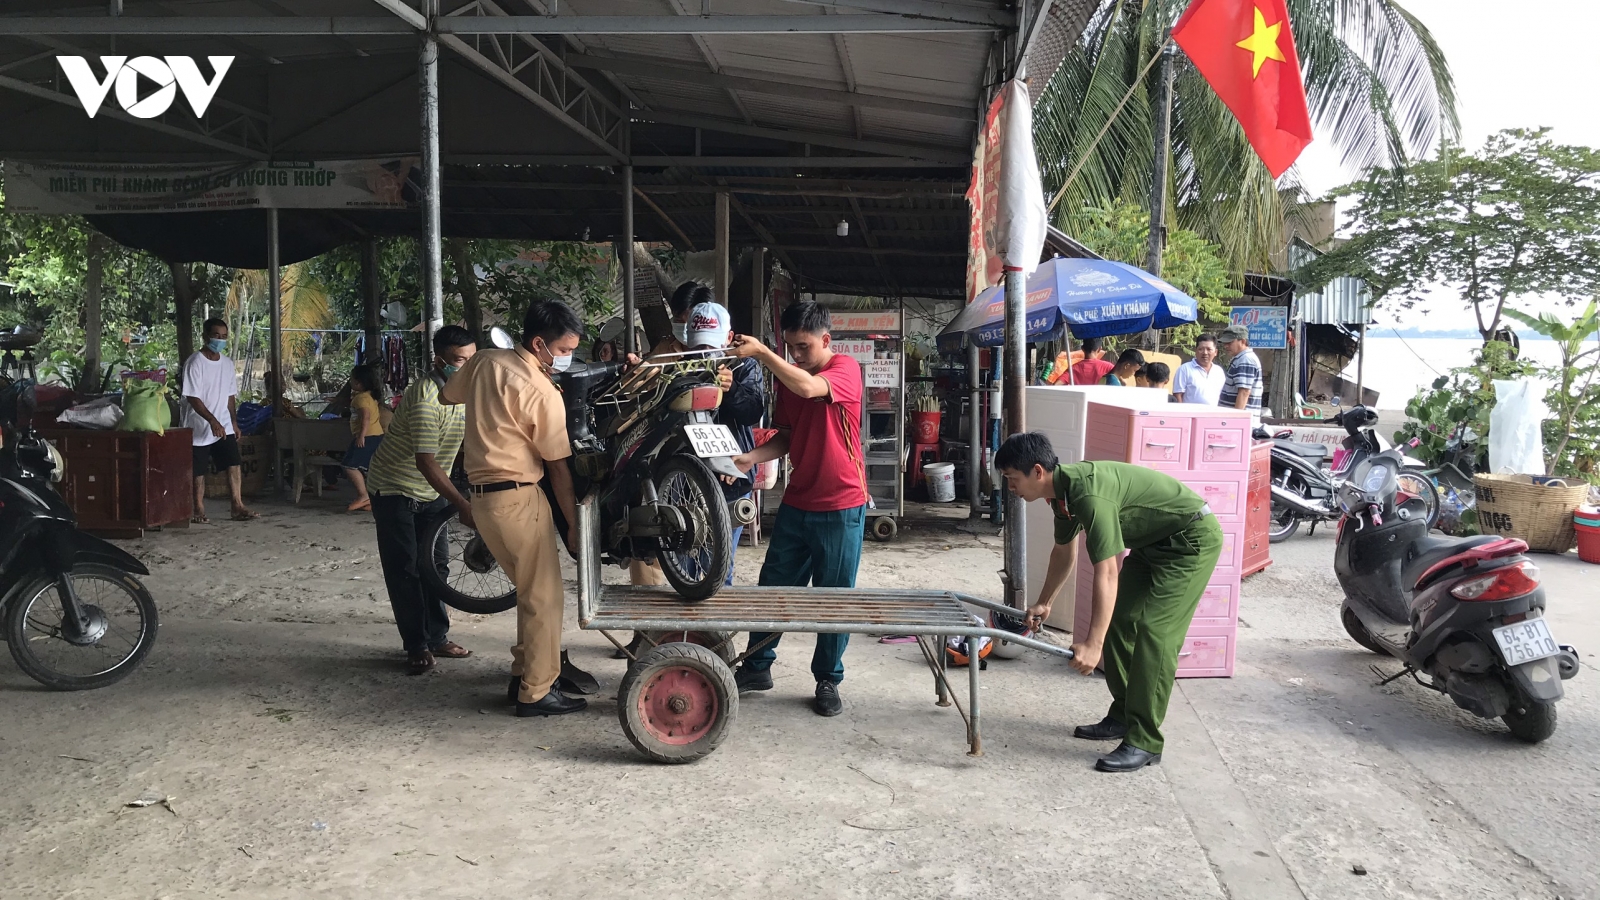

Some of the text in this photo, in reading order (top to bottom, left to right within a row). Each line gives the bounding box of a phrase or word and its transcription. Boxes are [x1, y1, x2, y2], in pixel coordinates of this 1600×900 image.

[49, 171, 87, 193] MIỄN
[92, 174, 117, 193] PHÍ
[123, 174, 168, 193] KHÁM
[237, 168, 288, 187] XƯƠNG
[293, 167, 337, 187] KHỚP
[1101, 301, 1122, 318] XUÂN
[1123, 299, 1150, 315] KHÁNH
[847, 317, 869, 327] KIM
[873, 314, 895, 327] YẾN
[831, 341, 872, 353] SỮA BẮP
[692, 427, 726, 440] 66-L1
[1301, 431, 1318, 443] HẢI
[696, 440, 738, 454] 405.84
[1502, 622, 1542, 645] 64-B1
[1504, 637, 1555, 663] 756.10
